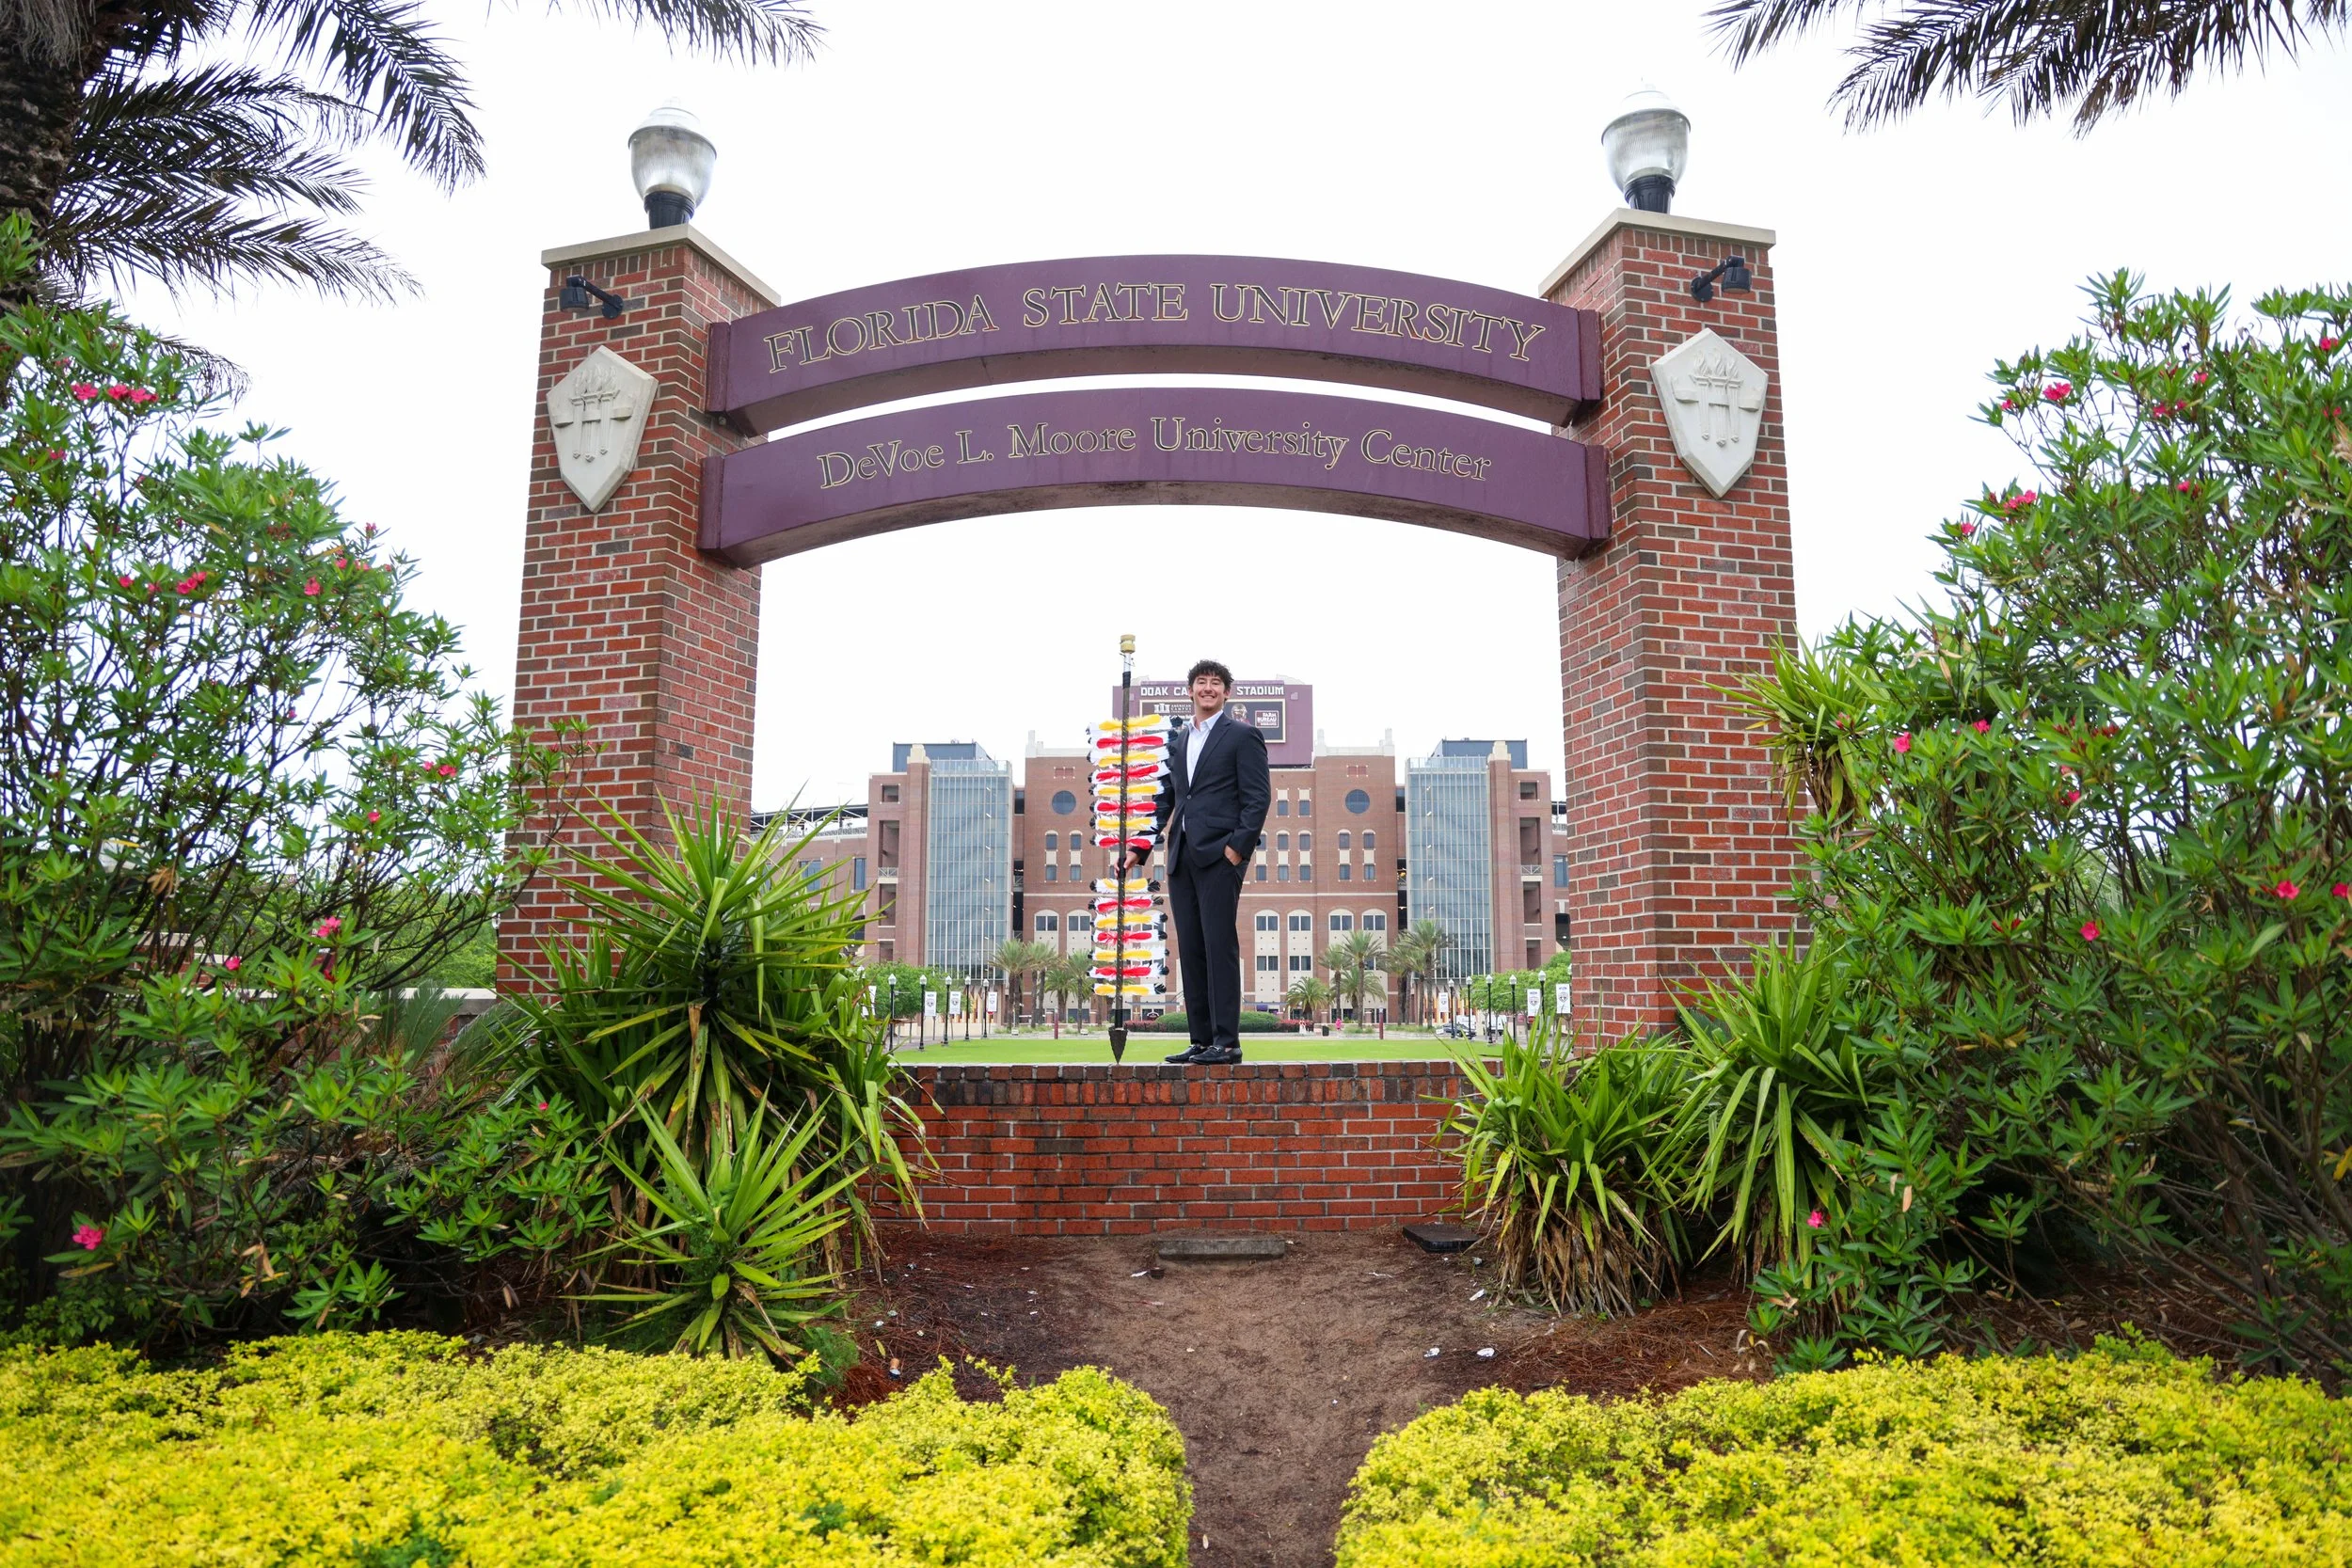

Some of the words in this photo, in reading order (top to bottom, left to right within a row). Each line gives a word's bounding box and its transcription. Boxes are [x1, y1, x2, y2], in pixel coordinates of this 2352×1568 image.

[764, 294, 999, 374] FLORIDA
[1023, 281, 1188, 327] STATE
[1210, 283, 1546, 361] UNIVERSITY
[817, 440, 945, 489] DeVoe
[955, 430, 993, 465] L.
[1007, 422, 1136, 459] Moore
[1151, 417, 1348, 469] University
[1360, 429, 1491, 482] Center
[1140, 687, 1168, 696] DOAK
[1236, 686, 1284, 696] STADIUM
